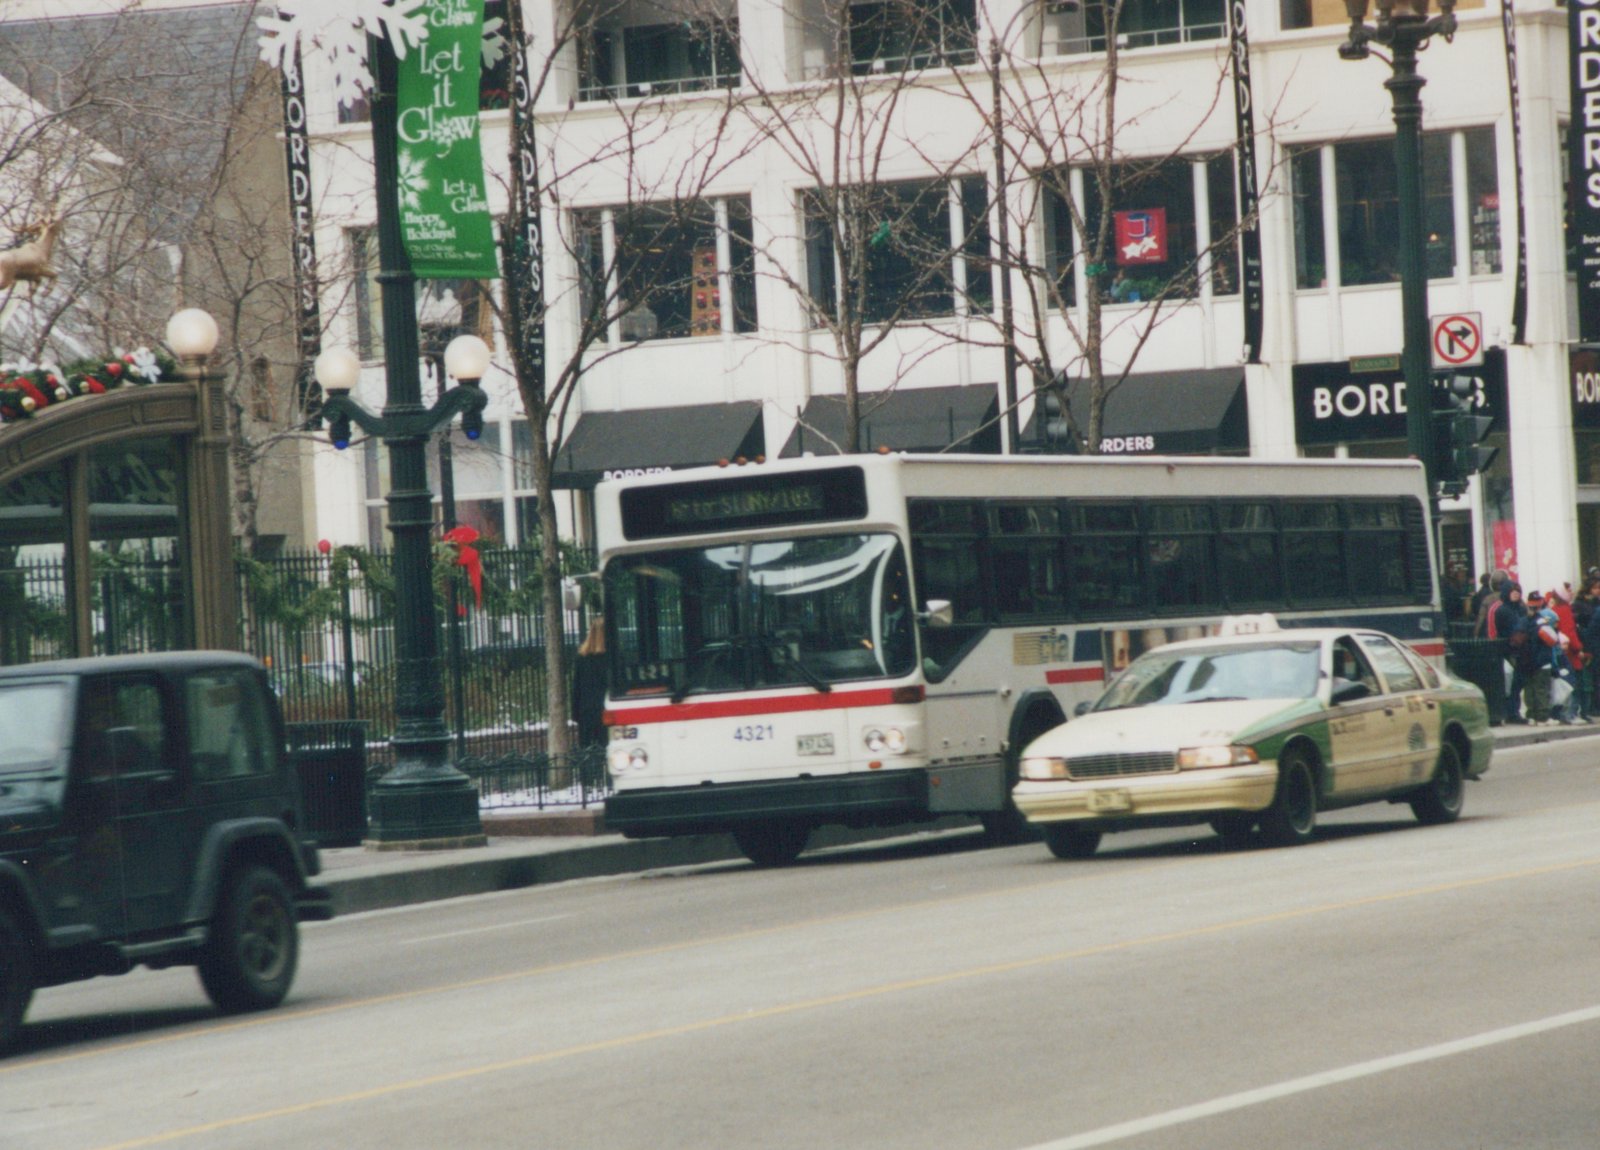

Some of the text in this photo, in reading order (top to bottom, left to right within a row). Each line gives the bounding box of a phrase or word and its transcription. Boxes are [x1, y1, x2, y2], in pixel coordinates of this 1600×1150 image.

[419, 41, 465, 74] Let
[433, 73, 456, 108] it
[443, 179, 479, 198] Let it
[1082, 436, 1154, 453] RDERS
[733, 725, 774, 740] 4321
